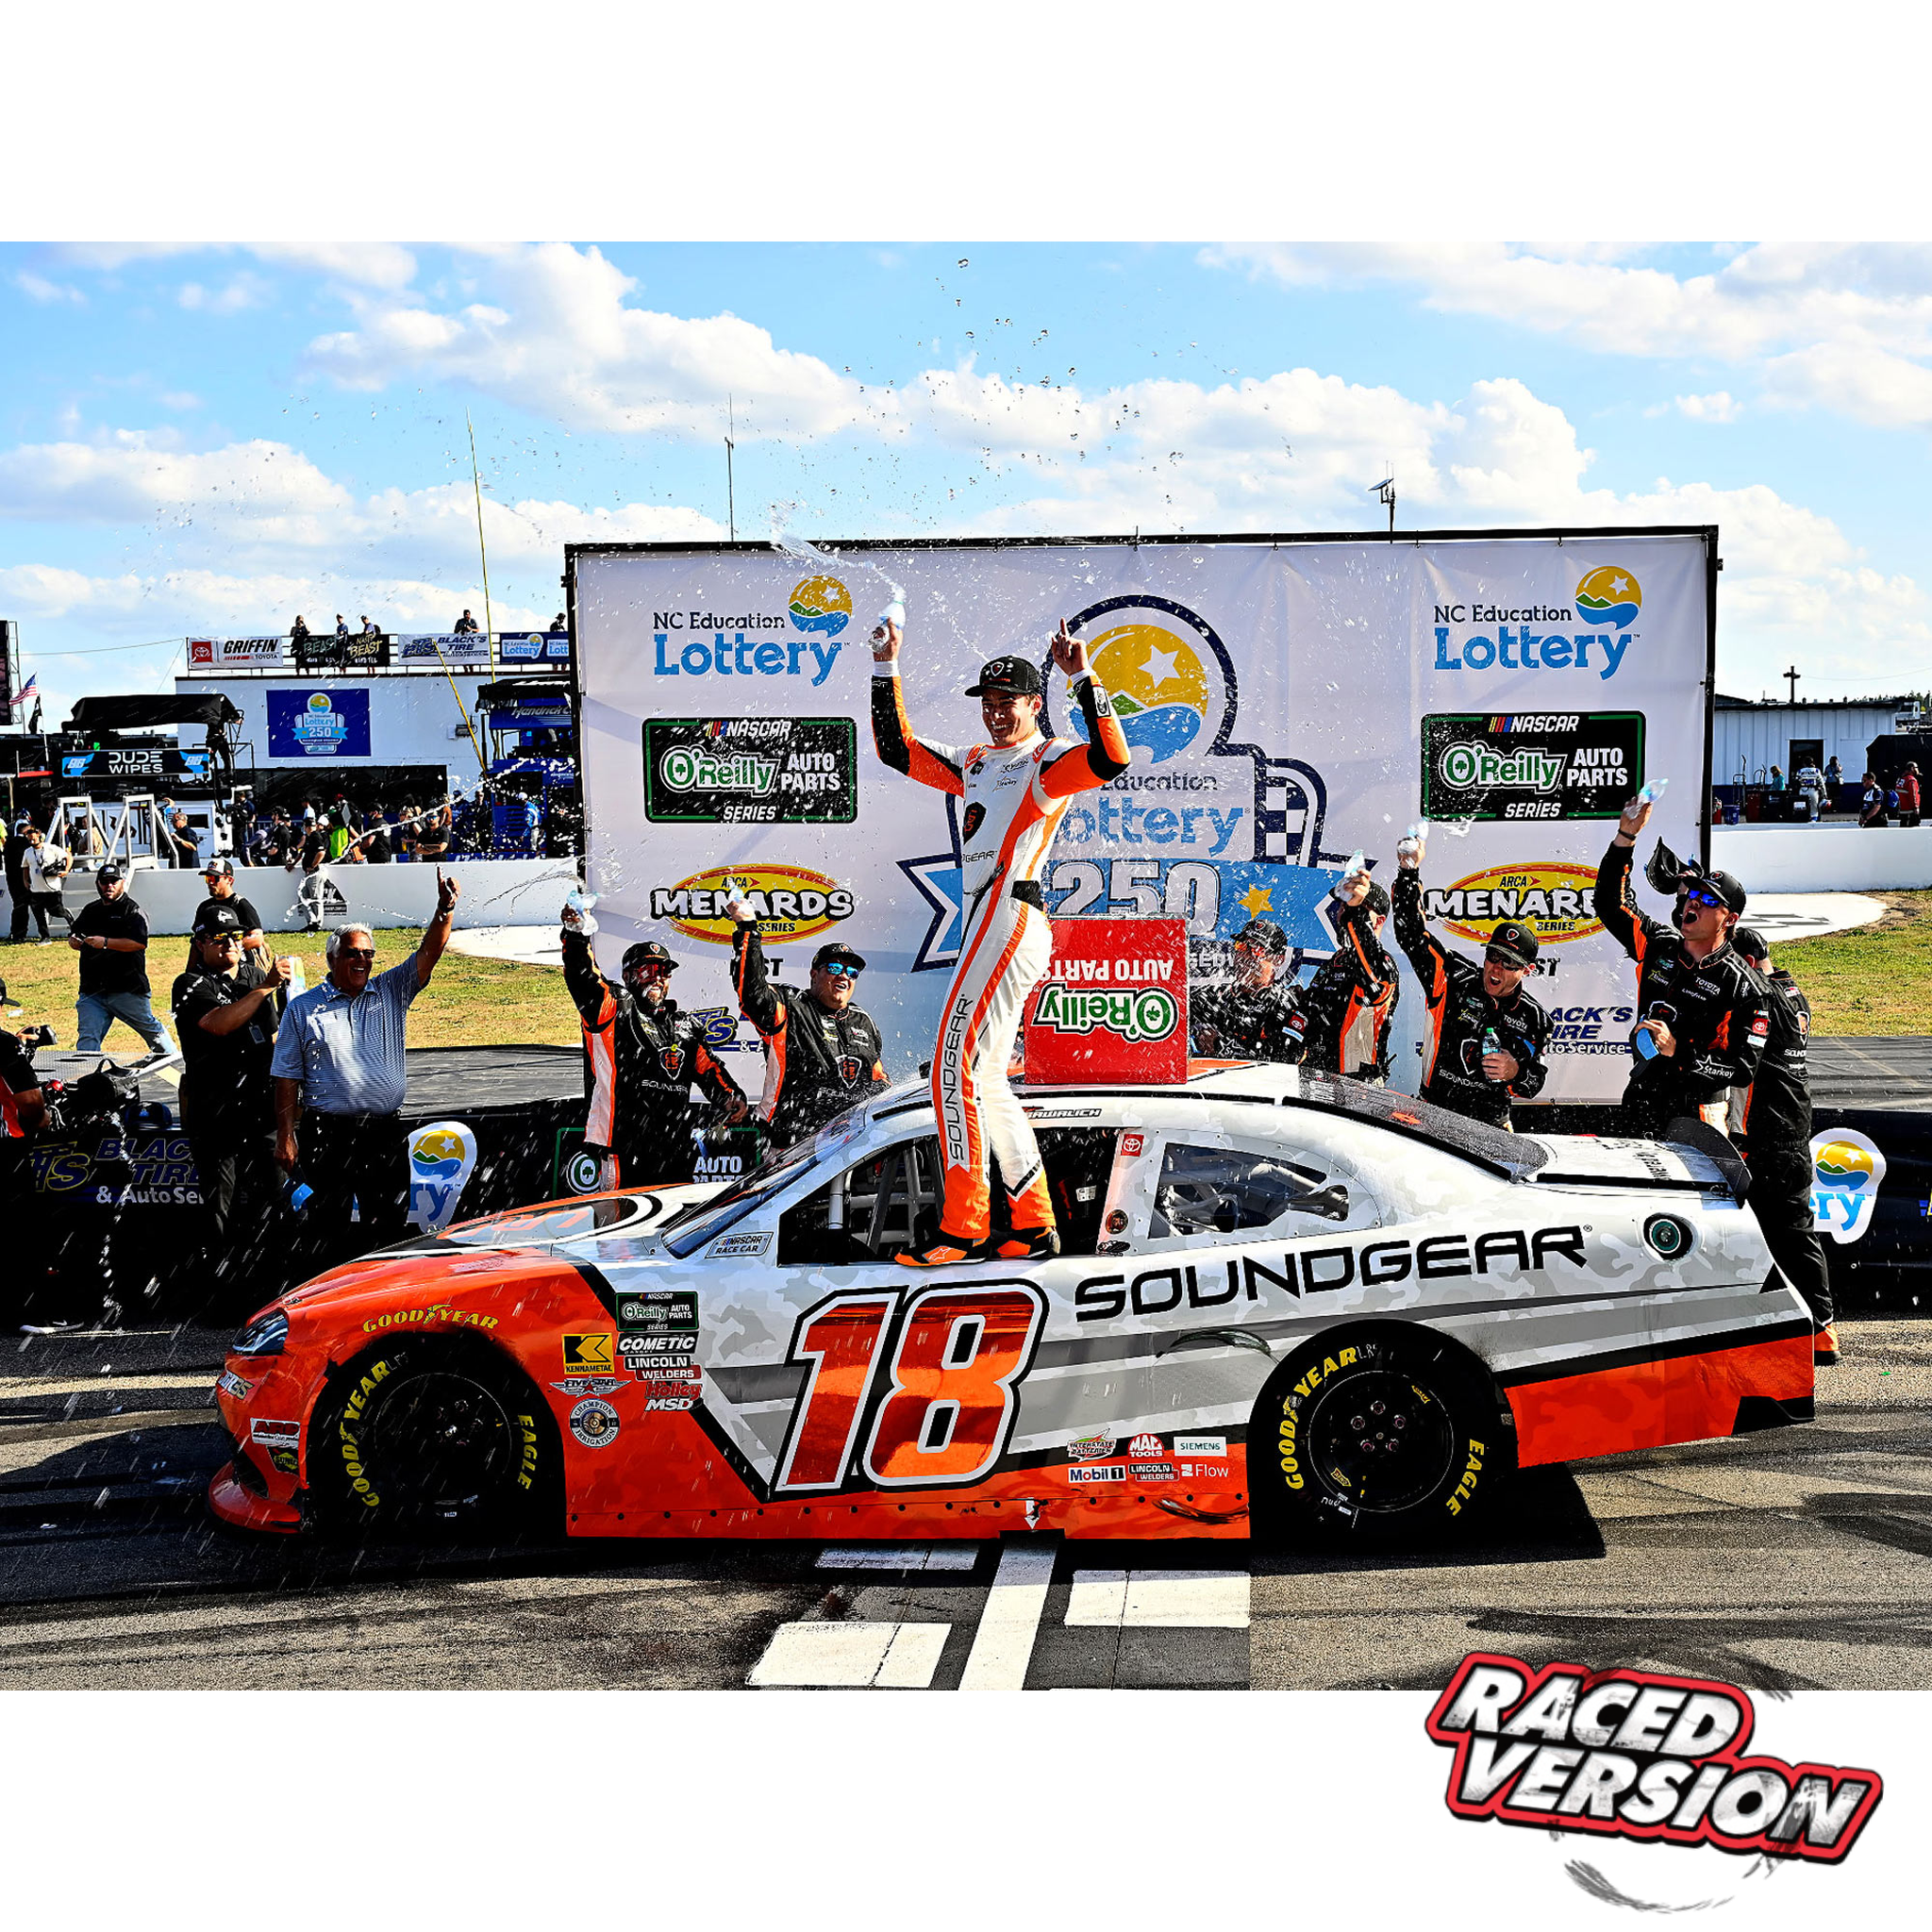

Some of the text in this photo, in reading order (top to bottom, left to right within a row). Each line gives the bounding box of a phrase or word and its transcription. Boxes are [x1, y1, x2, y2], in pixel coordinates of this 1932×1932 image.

[653, 612, 786, 630] NC Education
[1434, 604, 1573, 623] NC Education
[223, 639, 279, 654] GRIFFIN
[350, 641, 383, 658] BEAST
[504, 646, 541, 657] Lottery
[549, 646, 569, 655] Lott
[1434, 625, 1632, 681] Lottery
[654, 632, 842, 687] Lottery
[511, 707, 562, 716] Hendrick
[305, 718, 335, 726] Lottery
[725, 721, 792, 737] NASCAR
[1509, 715, 1580, 732] NASCAR
[308, 727, 332, 738] 250
[108, 751, 163, 763] DUDE
[786, 754, 836, 771] AUTO
[1573, 747, 1623, 767] AUTO
[108, 764, 163, 774] WIPES
[663, 747, 777, 793] O'Reilly
[1443, 744, 1562, 790] O'Reilly
[780, 773, 841, 791] PARTS
[1567, 768, 1628, 787] PARTS
[723, 806, 776, 822] SERIES
[1504, 803, 1562, 818] SERIES
[1056, 797, 1244, 858] ottery
[1499, 875, 1527, 888] ARCA
[1052, 860, 1221, 935] 250
[1425, 889, 1596, 920] MENAR
[758, 922, 795, 932] SERIES
[1536, 922, 1575, 931] SERIES
[1114, 959, 1174, 981] AUTO
[1695, 976, 1721, 995] TOYOTA
[1041, 989, 1174, 1036] O'Reilly
[1549, 1007, 1633, 1023] ACK'S
[1504, 1014, 1528, 1031] TOYOTA
[1551, 1024, 1602, 1040] IRE
[1784, 1048, 1807, 1057] SOUND
[943, 997, 974, 1161] SOUNDGEAR
[1703, 1064, 1735, 1078] Starkey
[93, 1137, 194, 1162] BLAC
[693, 1156, 742, 1174] AUTO
[95, 1185, 113, 1205] &
[120, 1186, 172, 1205] Auto
[728, 1236, 763, 1245] NASCAR
[715, 1246, 740, 1255] RACE
[1075, 1225, 1588, 1323] SOUNDGEAR
[623, 1302, 668, 1321] O'Reilly
[668, 1311, 692, 1320] PARTS
[671, 1304, 691, 1312] AUTO
[362, 1304, 500, 1333] GOODYEAR
[619, 1336, 695, 1352] COMETIC
[566, 1364, 613, 1373] KENNAMETAL
[627, 1357, 688, 1369] LINCOLN
[641, 1370, 694, 1379] WELDERS
[645, 1381, 703, 1401] Holley
[777, 1280, 1048, 1494] 18
[574, 1401, 614, 1417] CHAMPION
[644, 1398, 693, 1411] MSD
[1278, 1346, 1357, 1490] GOODYEAR
[575, 1428, 616, 1446] IRRIGATION
[1129, 1435, 1163, 1452] MAC
[518, 1415, 538, 1491] EAGLE
[1179, 1442, 1221, 1451] SIEMENS
[1070, 1468, 1108, 1481] Mobil
[1131, 1464, 1171, 1474] LINCOLN
[1195, 1464, 1229, 1477] Flow
[1445, 1439, 1485, 1516] EAGLE
